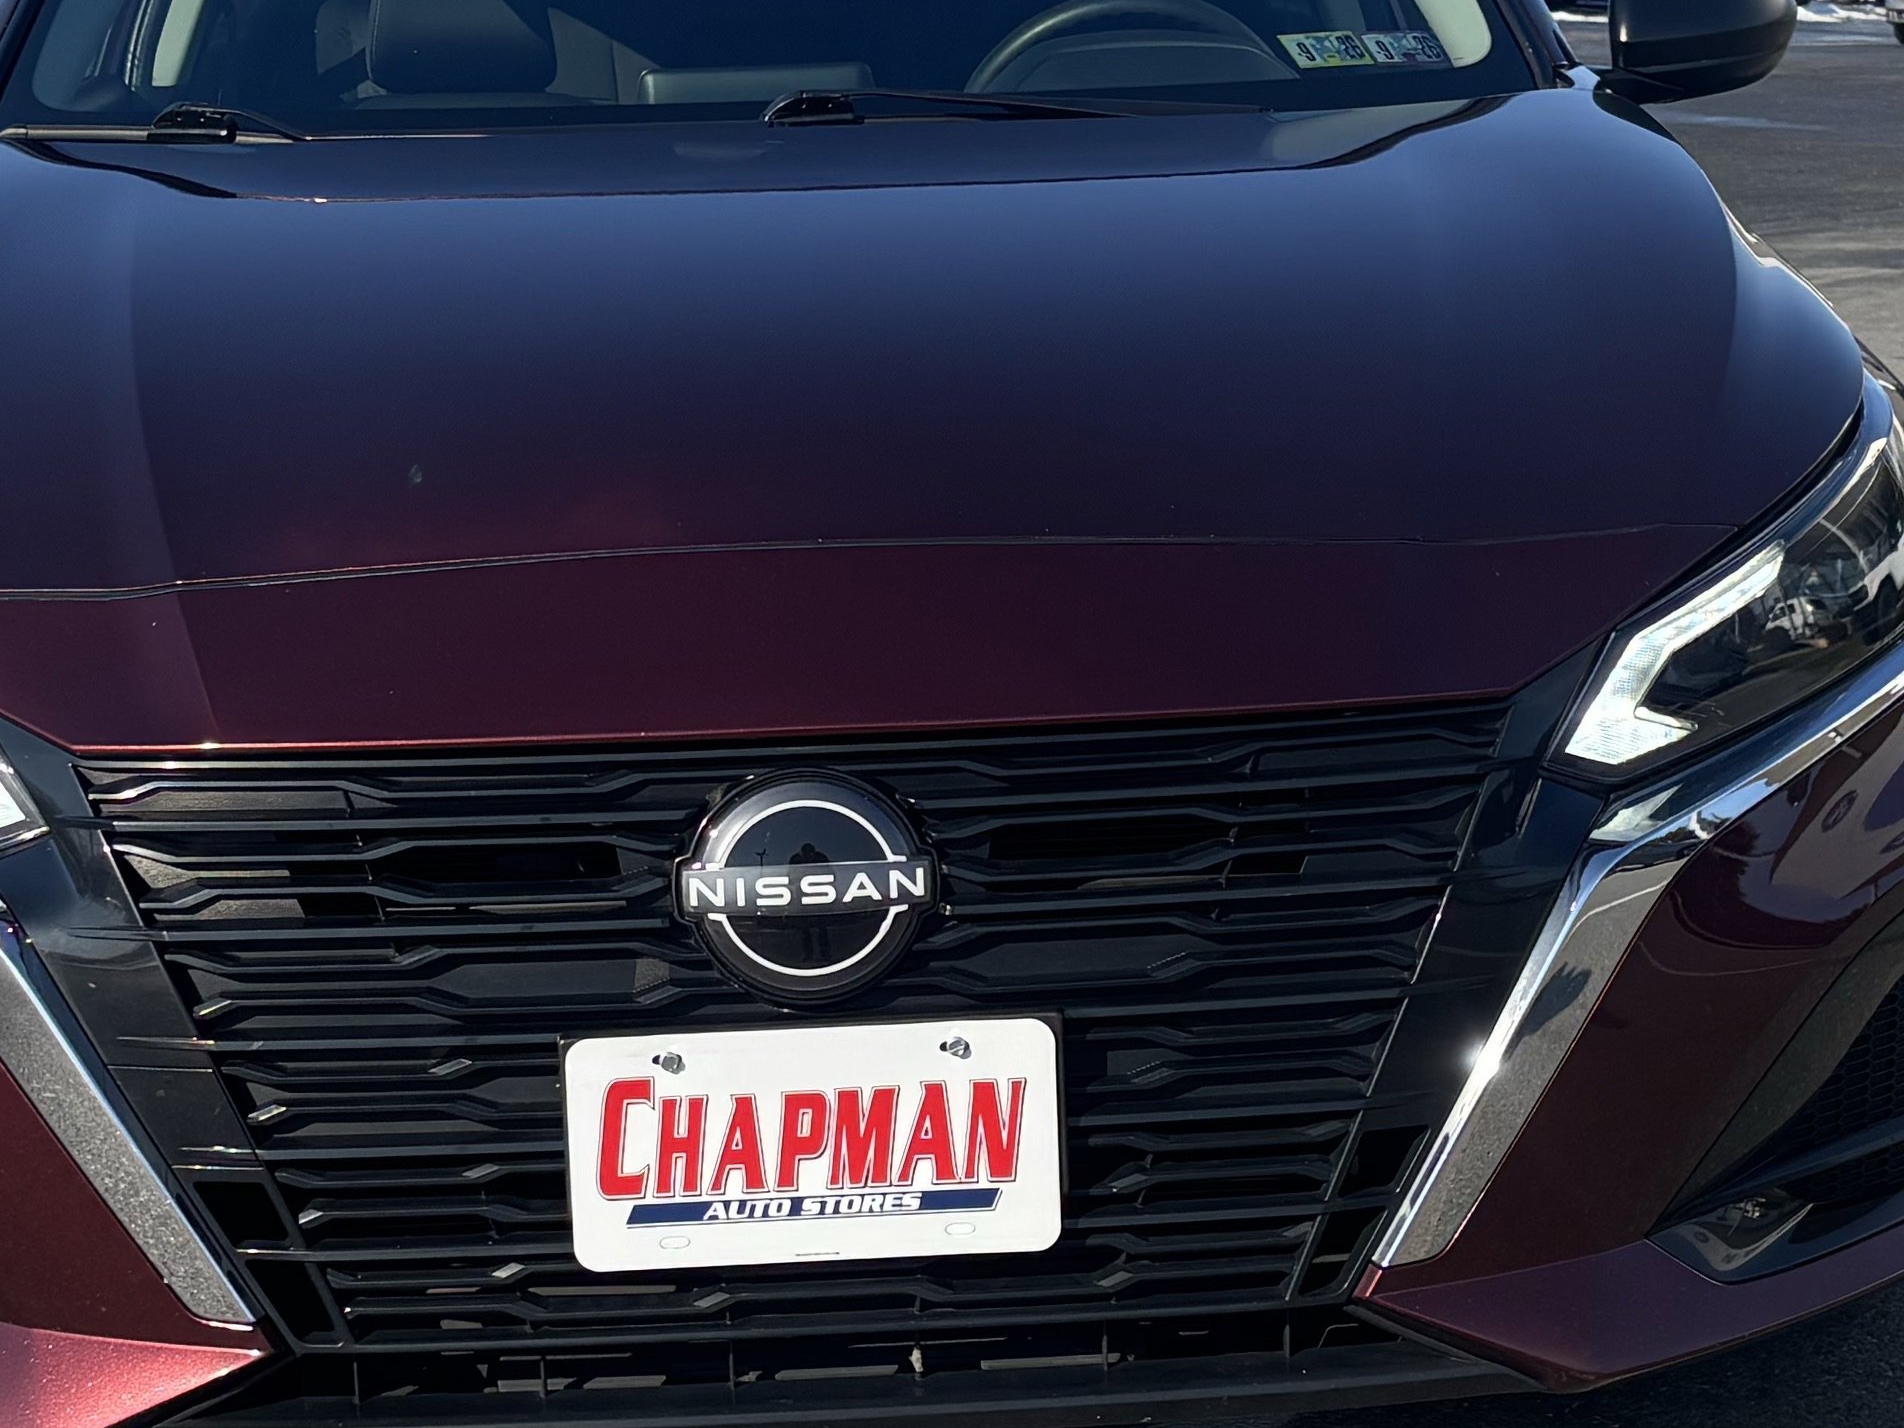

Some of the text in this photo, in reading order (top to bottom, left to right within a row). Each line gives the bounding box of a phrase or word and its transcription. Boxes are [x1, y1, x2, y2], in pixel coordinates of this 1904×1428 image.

[688, 868, 925, 907] NISSAN
[596, 1076, 1027, 1200] CHAPMAN
[703, 1192, 923, 1220] AUTO STORES
